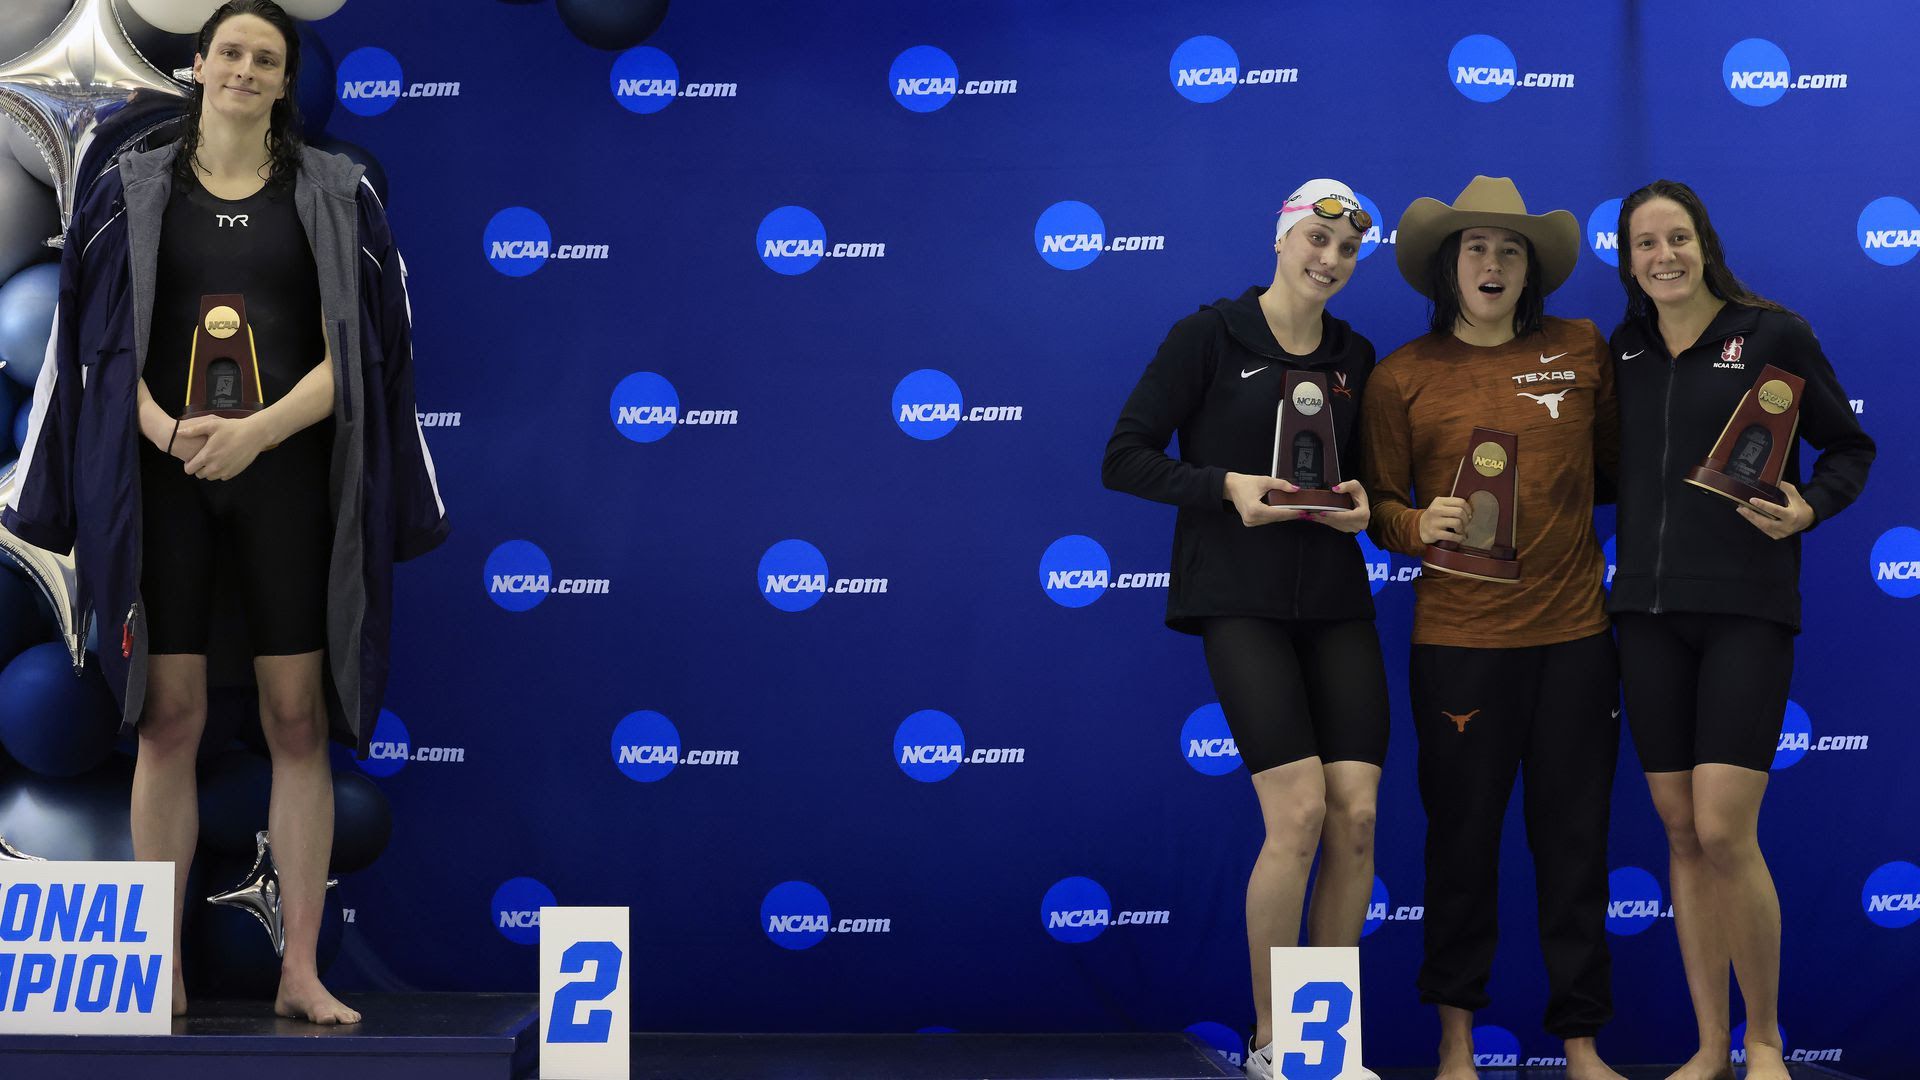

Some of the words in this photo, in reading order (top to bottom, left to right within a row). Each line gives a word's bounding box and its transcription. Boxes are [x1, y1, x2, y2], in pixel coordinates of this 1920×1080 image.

[896, 77, 1018, 96] NCAA.com
[1177, 67, 1298, 87] NCAA.com
[1455, 66, 1575, 88] NCAA.com
[1730, 70, 1848, 89] NCAA.com
[342, 80, 460, 99] NCAA.com
[617, 79, 738, 97] NCAA.com
[215, 214, 249, 228] TYR
[763, 239, 886, 258] NCAA.com
[1042, 233, 1165, 253] NCAA.com
[1864, 229, 1920, 249] NCAA
[490, 240, 610, 259] NCAA.com
[207, 320, 239, 331] NCAA
[1511, 370, 1576, 384] TEXAS
[1295, 396, 1322, 408] NCAA
[1759, 390, 1790, 410] NCAA
[617, 406, 739, 425] NCAA.com
[899, 403, 1023, 422] NCAA.com
[1474, 456, 1505, 471] NCAA
[491, 575, 610, 594] NCAA.com
[764, 574, 888, 594] NCAA.com
[1046, 569, 1171, 590] NCAA.com
[1776, 732, 1869, 752] AA.com
[369, 742, 465, 763] CAA.com
[618, 745, 740, 765] NCAA.com
[900, 745, 1025, 764] NCAA.com
[0, 883, 148, 943] ONAL
[1049, 909, 1170, 928] NCAA.com
[1607, 900, 1675, 919] NCAA.
[768, 915, 891, 934] NCAA.com
[0, 953, 163, 1013] PION
[546, 941, 623, 1043] 2
[1281, 981, 1354, 1080] 3
[1730, 1048, 1843, 1063] N.com
